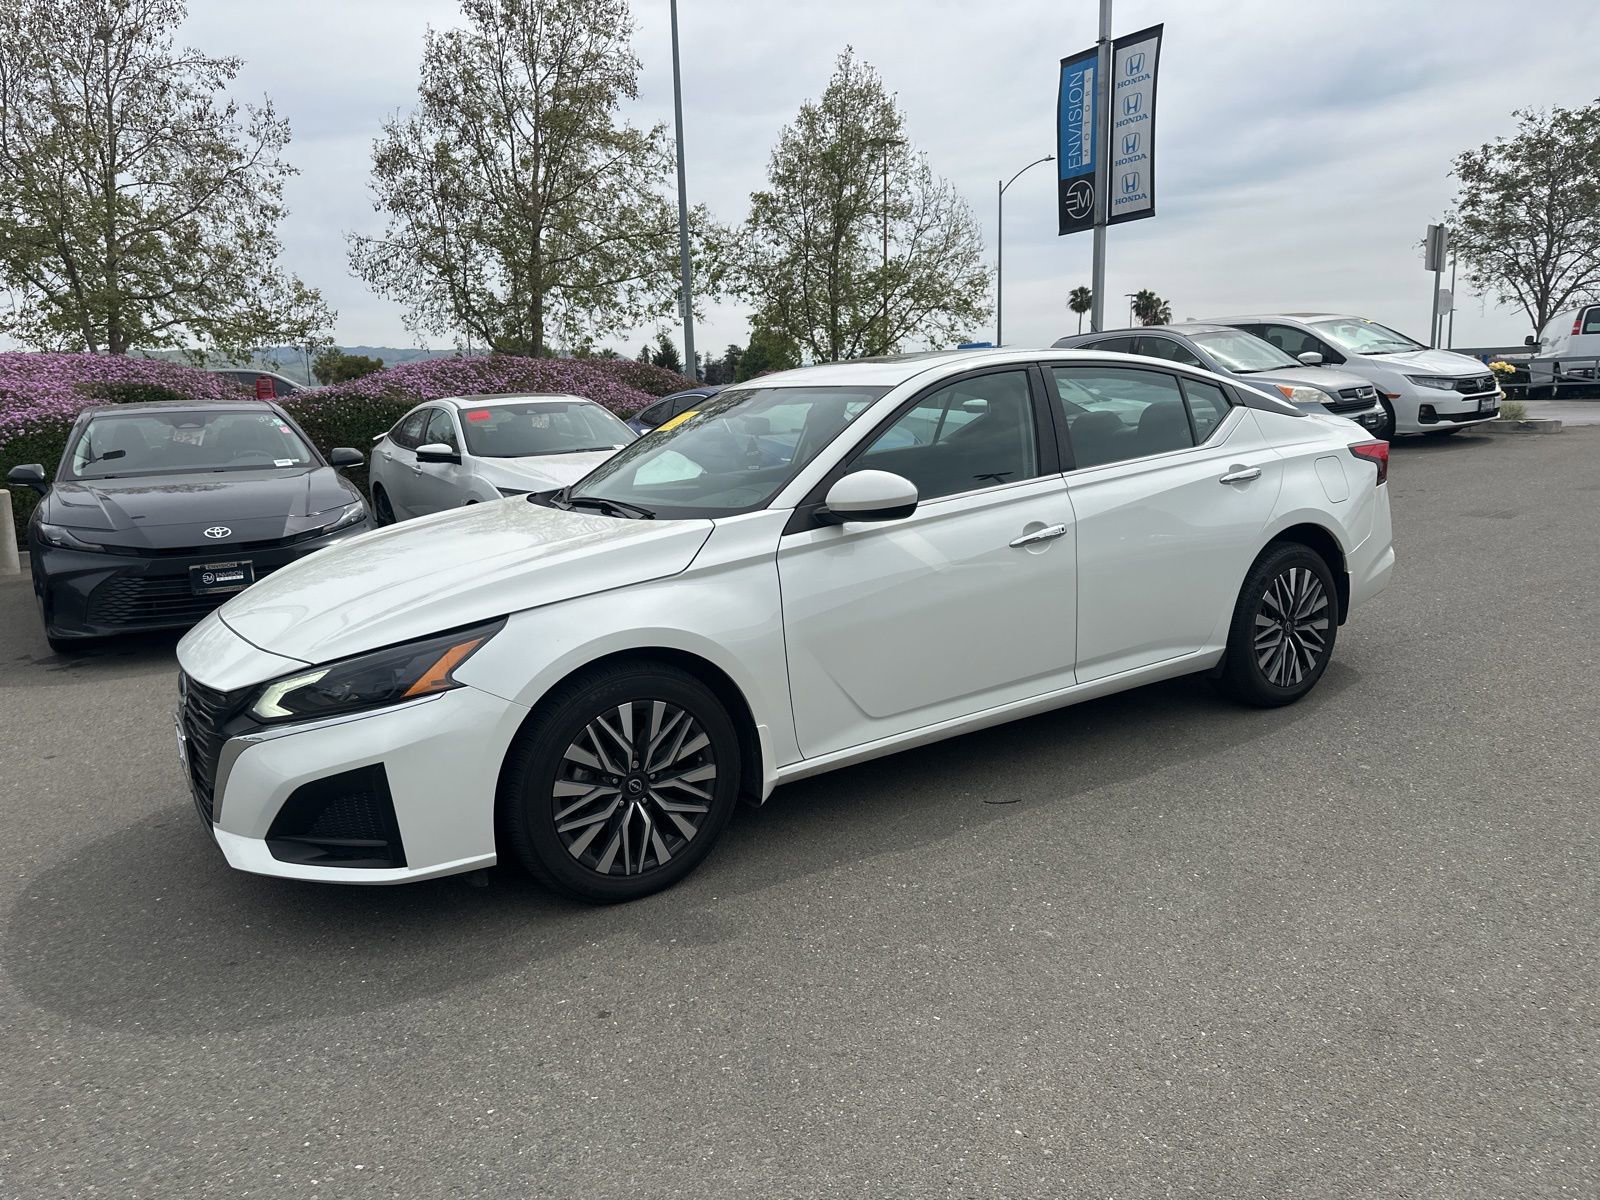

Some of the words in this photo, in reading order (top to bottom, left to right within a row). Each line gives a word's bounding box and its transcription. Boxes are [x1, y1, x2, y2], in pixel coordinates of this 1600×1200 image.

[1117, 73, 1151, 88] HONDA
[1068, 70, 1083, 169] ENVISION
[1116, 113, 1149, 128] HONDA
[1115, 153, 1148, 166] HONDA
[1115, 192, 1148, 205] HONDA
